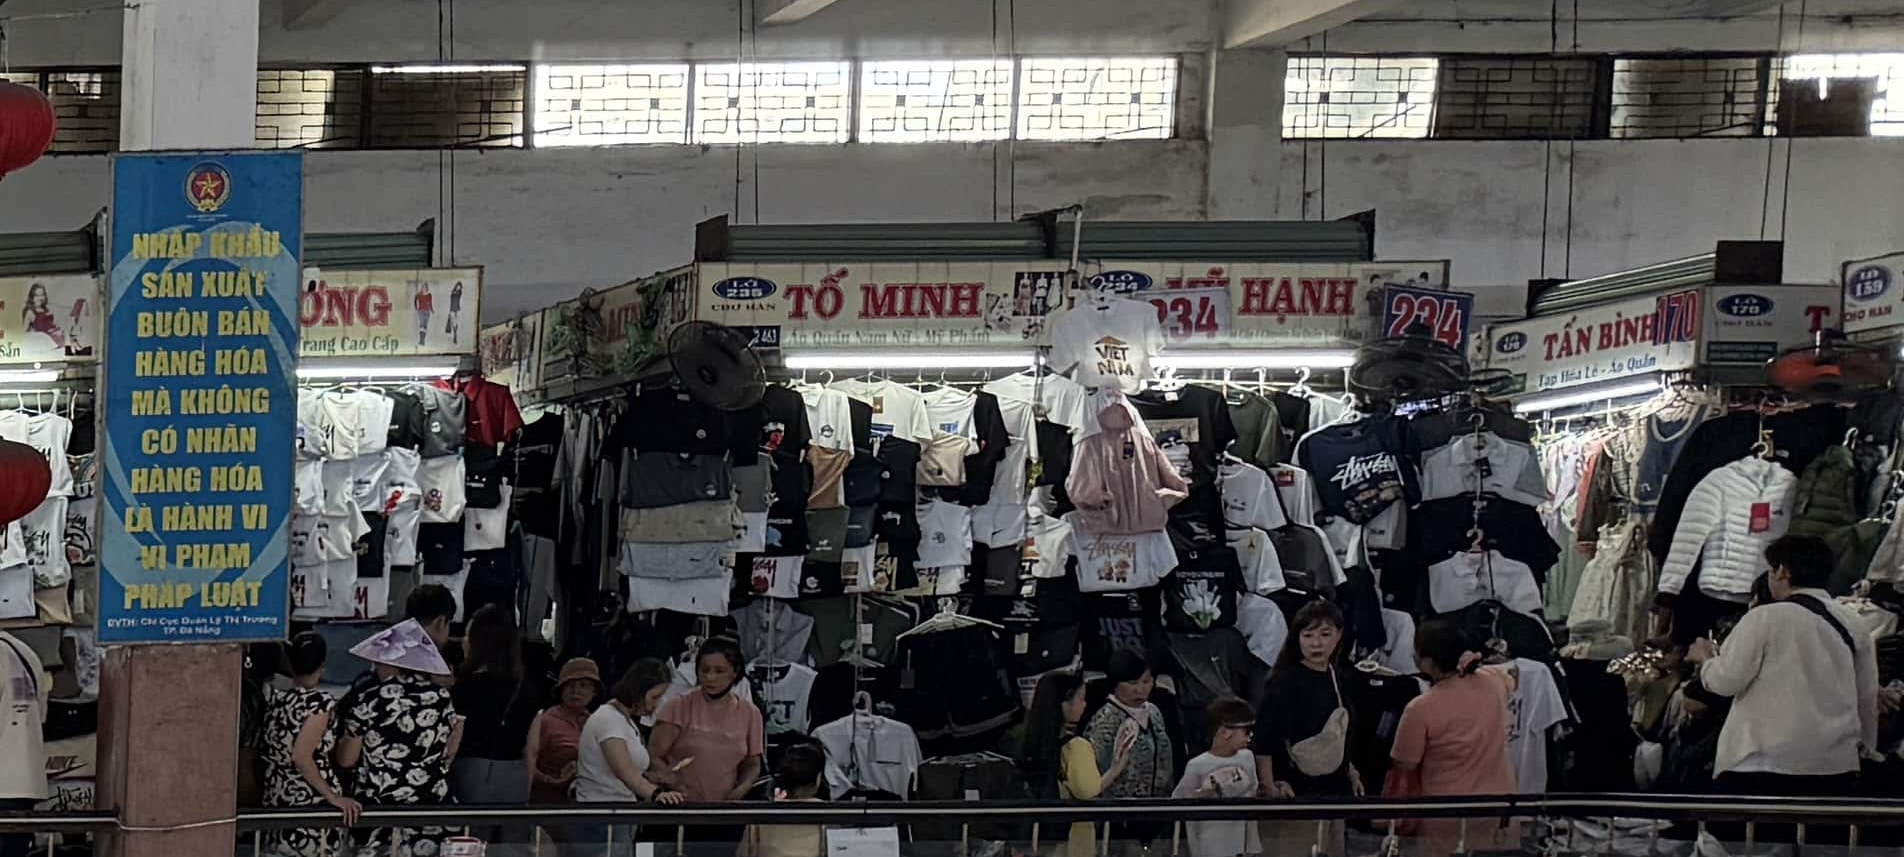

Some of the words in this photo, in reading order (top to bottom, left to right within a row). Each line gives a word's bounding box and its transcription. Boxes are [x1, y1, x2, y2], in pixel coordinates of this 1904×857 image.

[142, 266, 193, 298] SẢN
[201, 264, 268, 297] XUẤT
[783, 267, 850, 320] TỐ
[858, 282, 986, 319] MINH
[1238, 278, 1359, 325] HẠNH
[137, 307, 208, 338] BUÔN
[217, 306, 271, 336] BÁN
[1656, 290, 1699, 346] 170
[340, 337, 367, 352] Cao
[855, 330, 888, 344] Nam
[1542, 314, 1594, 361] TẤN
[1597, 309, 1656, 350] BÌNH
[135, 346, 206, 377] HÀNG
[215, 345, 268, 375] HÓA
[131, 386, 172, 416] MÀ
[180, 384, 271, 414] KHÔNG
[142, 425, 177, 455] CÓ
[186, 423, 257, 454] NHÃN
[130, 463, 202, 494] HÀNG
[210, 462, 264, 492] HÓA
[124, 503, 154, 533] LÀ
[162, 501, 234, 531] HÀNH
[241, 504, 268, 530] VI
[141, 545, 167, 570] VI
[200, 576, 264, 611] LUẬT
[1098, 617, 1144, 636] JUST
